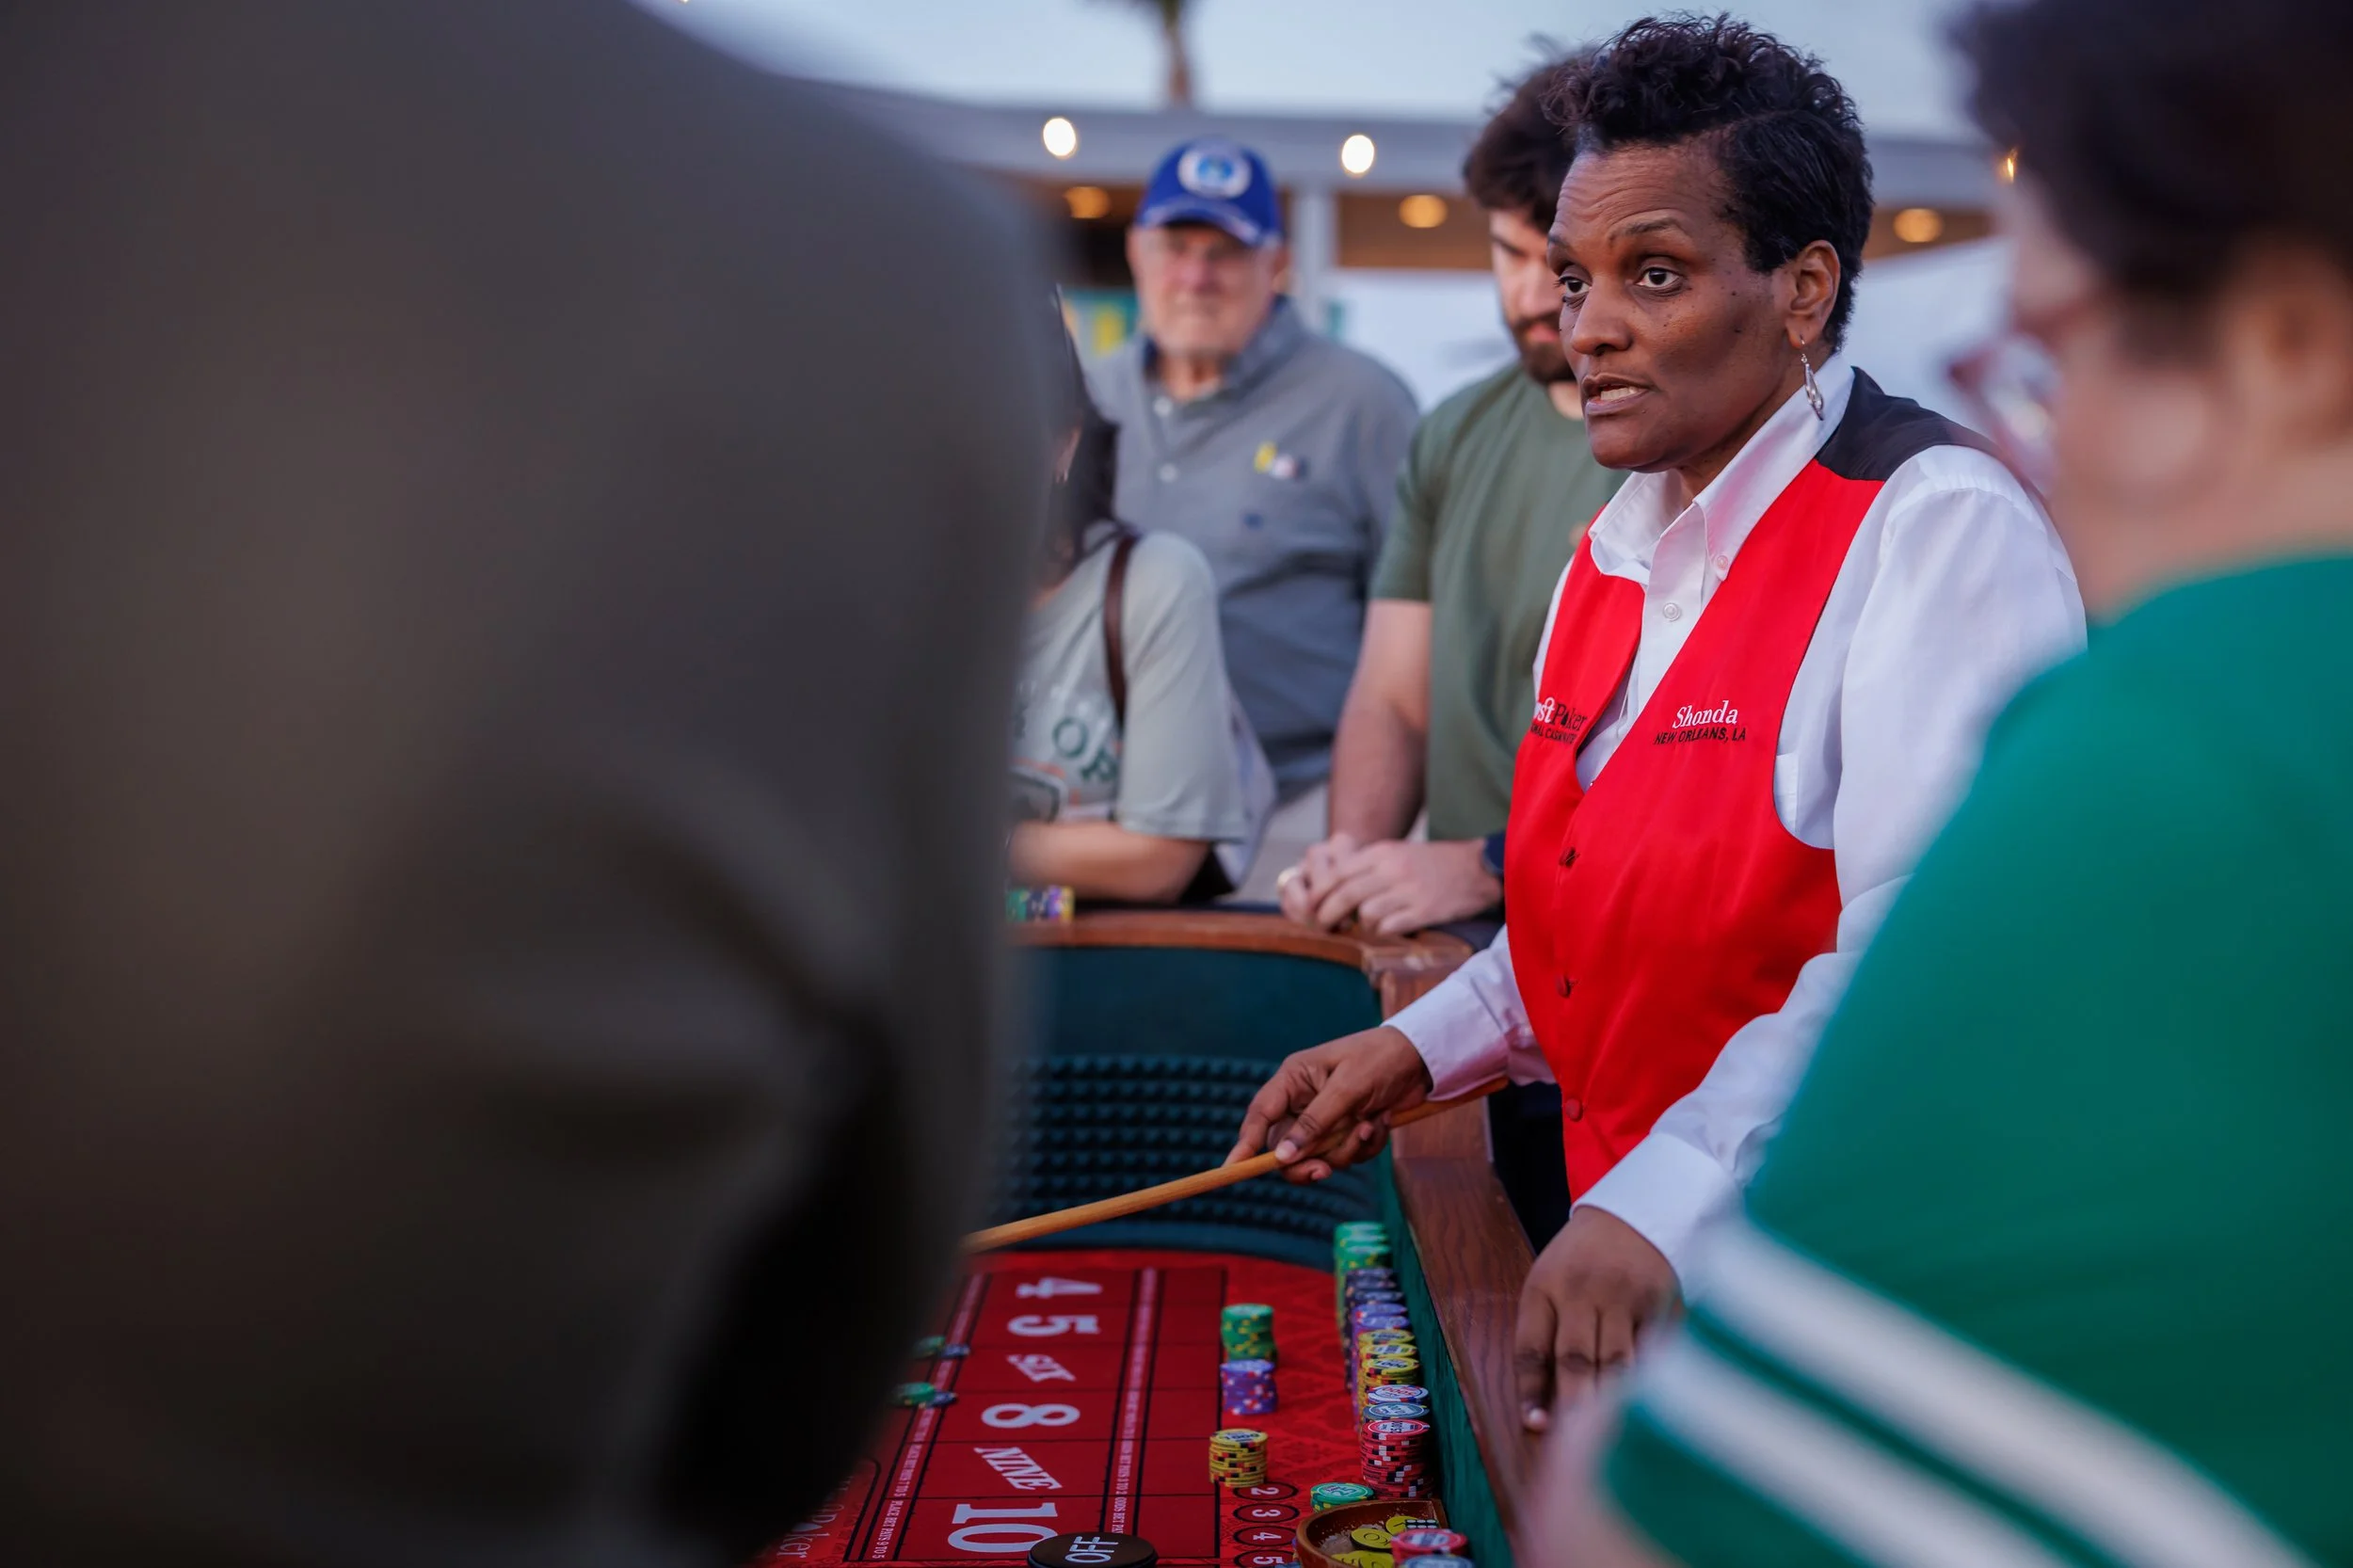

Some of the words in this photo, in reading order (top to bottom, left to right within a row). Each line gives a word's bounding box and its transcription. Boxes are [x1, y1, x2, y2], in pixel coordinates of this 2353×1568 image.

[1673, 699, 1738, 728] Shonda
[1654, 731, 1676, 744] NEW
[1678, 726, 1729, 744] ORLEANS,
[1732, 727, 1746, 741] LA
[1007, 1315, 1101, 1336] 5
[1006, 1353, 1076, 1383] SIX
[981, 1402, 1080, 1428] 8
[973, 1447, 1063, 1490] NINE
[1251, 1487, 1280, 1496] 2
[887, 1500, 904, 1516] PLACE
[1113, 1497, 1128, 1512] ODDS
[1112, 1512, 1126, 1523] BET
[1252, 1509, 1281, 1518] 3
[883, 1517, 898, 1527] BET
[947, 1502, 1058, 1553] 10
[878, 1528, 894, 1541] PAYS
[1253, 1531, 1282, 1541] 4
[1064, 1536, 1119, 1563] OFF
[1253, 1556, 1285, 1565] 5
